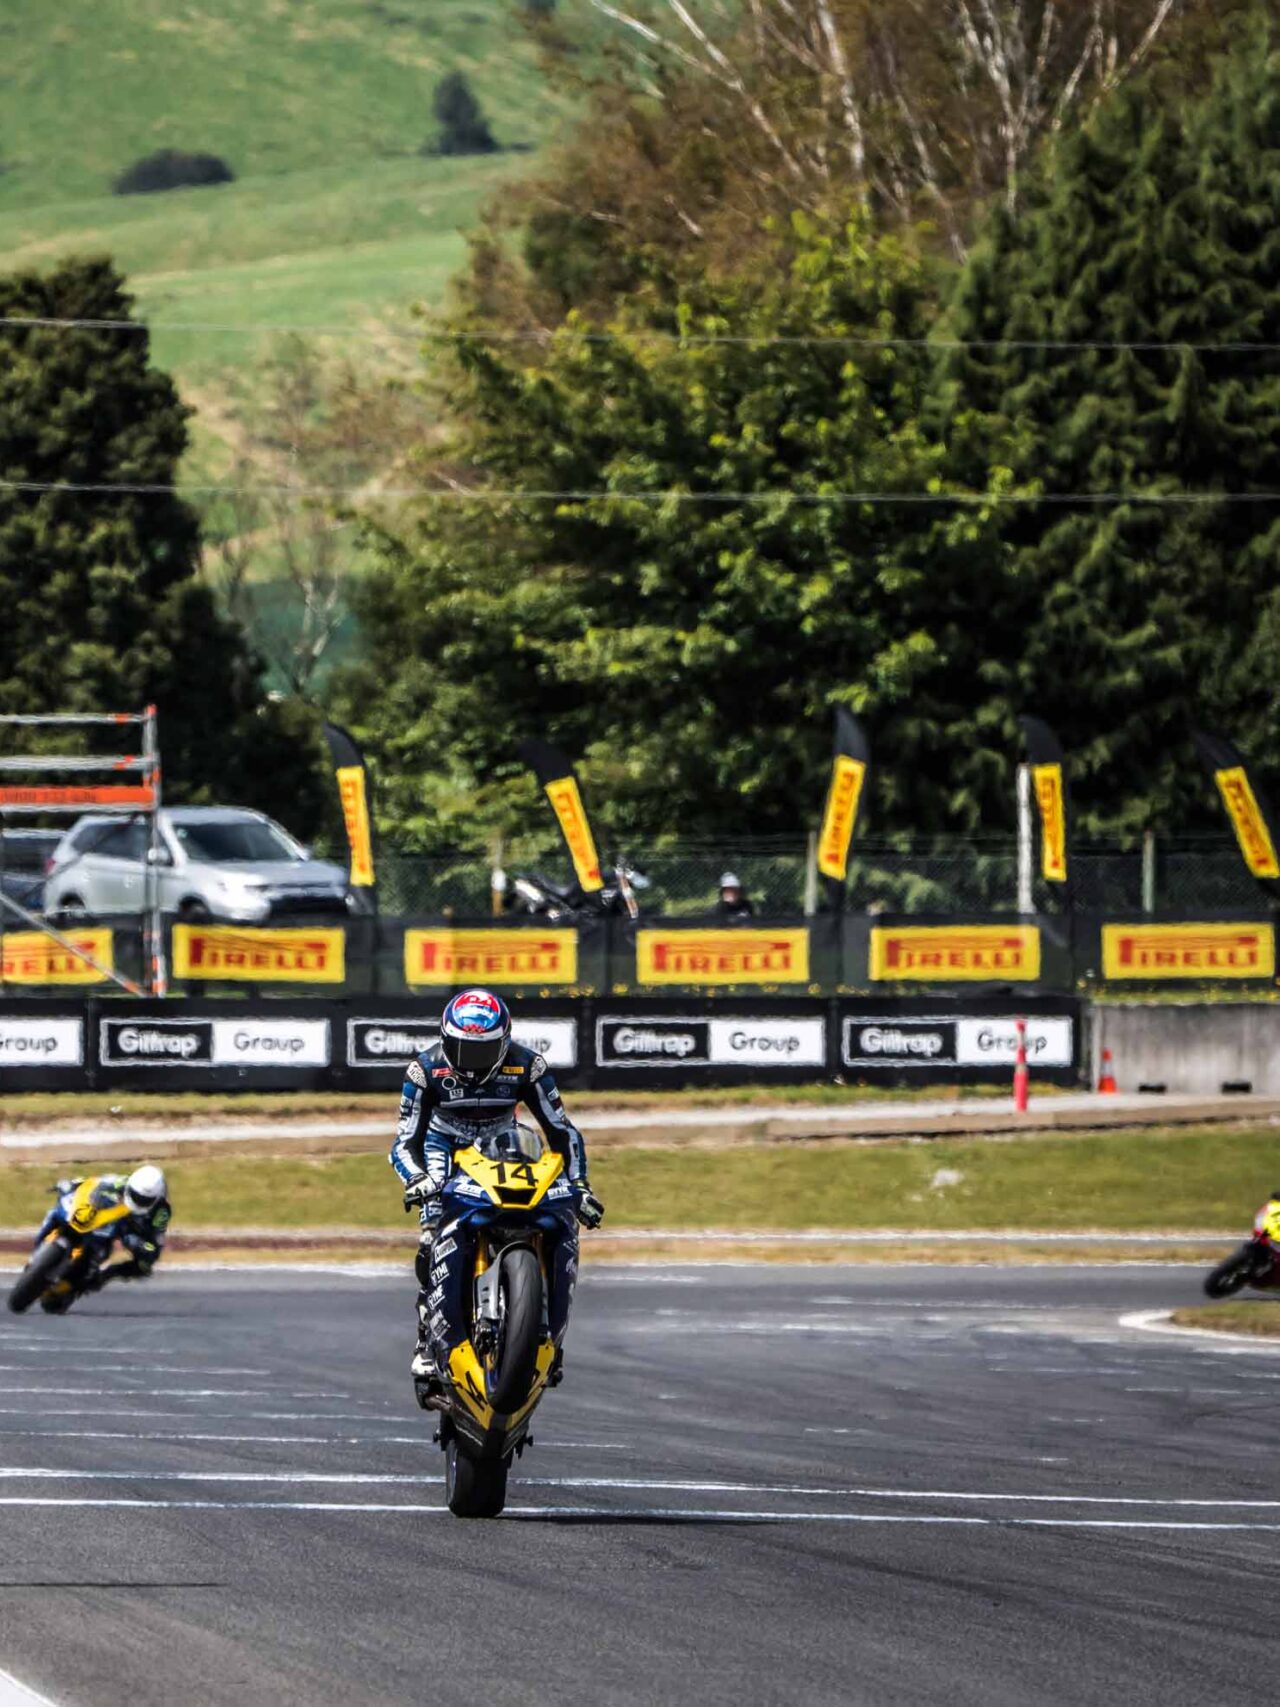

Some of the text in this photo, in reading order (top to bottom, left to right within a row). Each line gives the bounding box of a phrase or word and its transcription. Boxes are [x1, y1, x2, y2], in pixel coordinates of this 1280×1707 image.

[190, 937, 328, 971] PIRELLI
[422, 940, 560, 972] PIRELLI
[652, 941, 792, 972] PIRELLI
[885, 938, 1024, 968] PIRELLI
[1118, 936, 1258, 966] PIRELLI
[117, 1027, 305, 1058] Giltrap Group
[613, 1027, 801, 1057] Giltrap Group
[860, 1027, 944, 1057] Giltrap
[490, 1160, 539, 1187] 14
